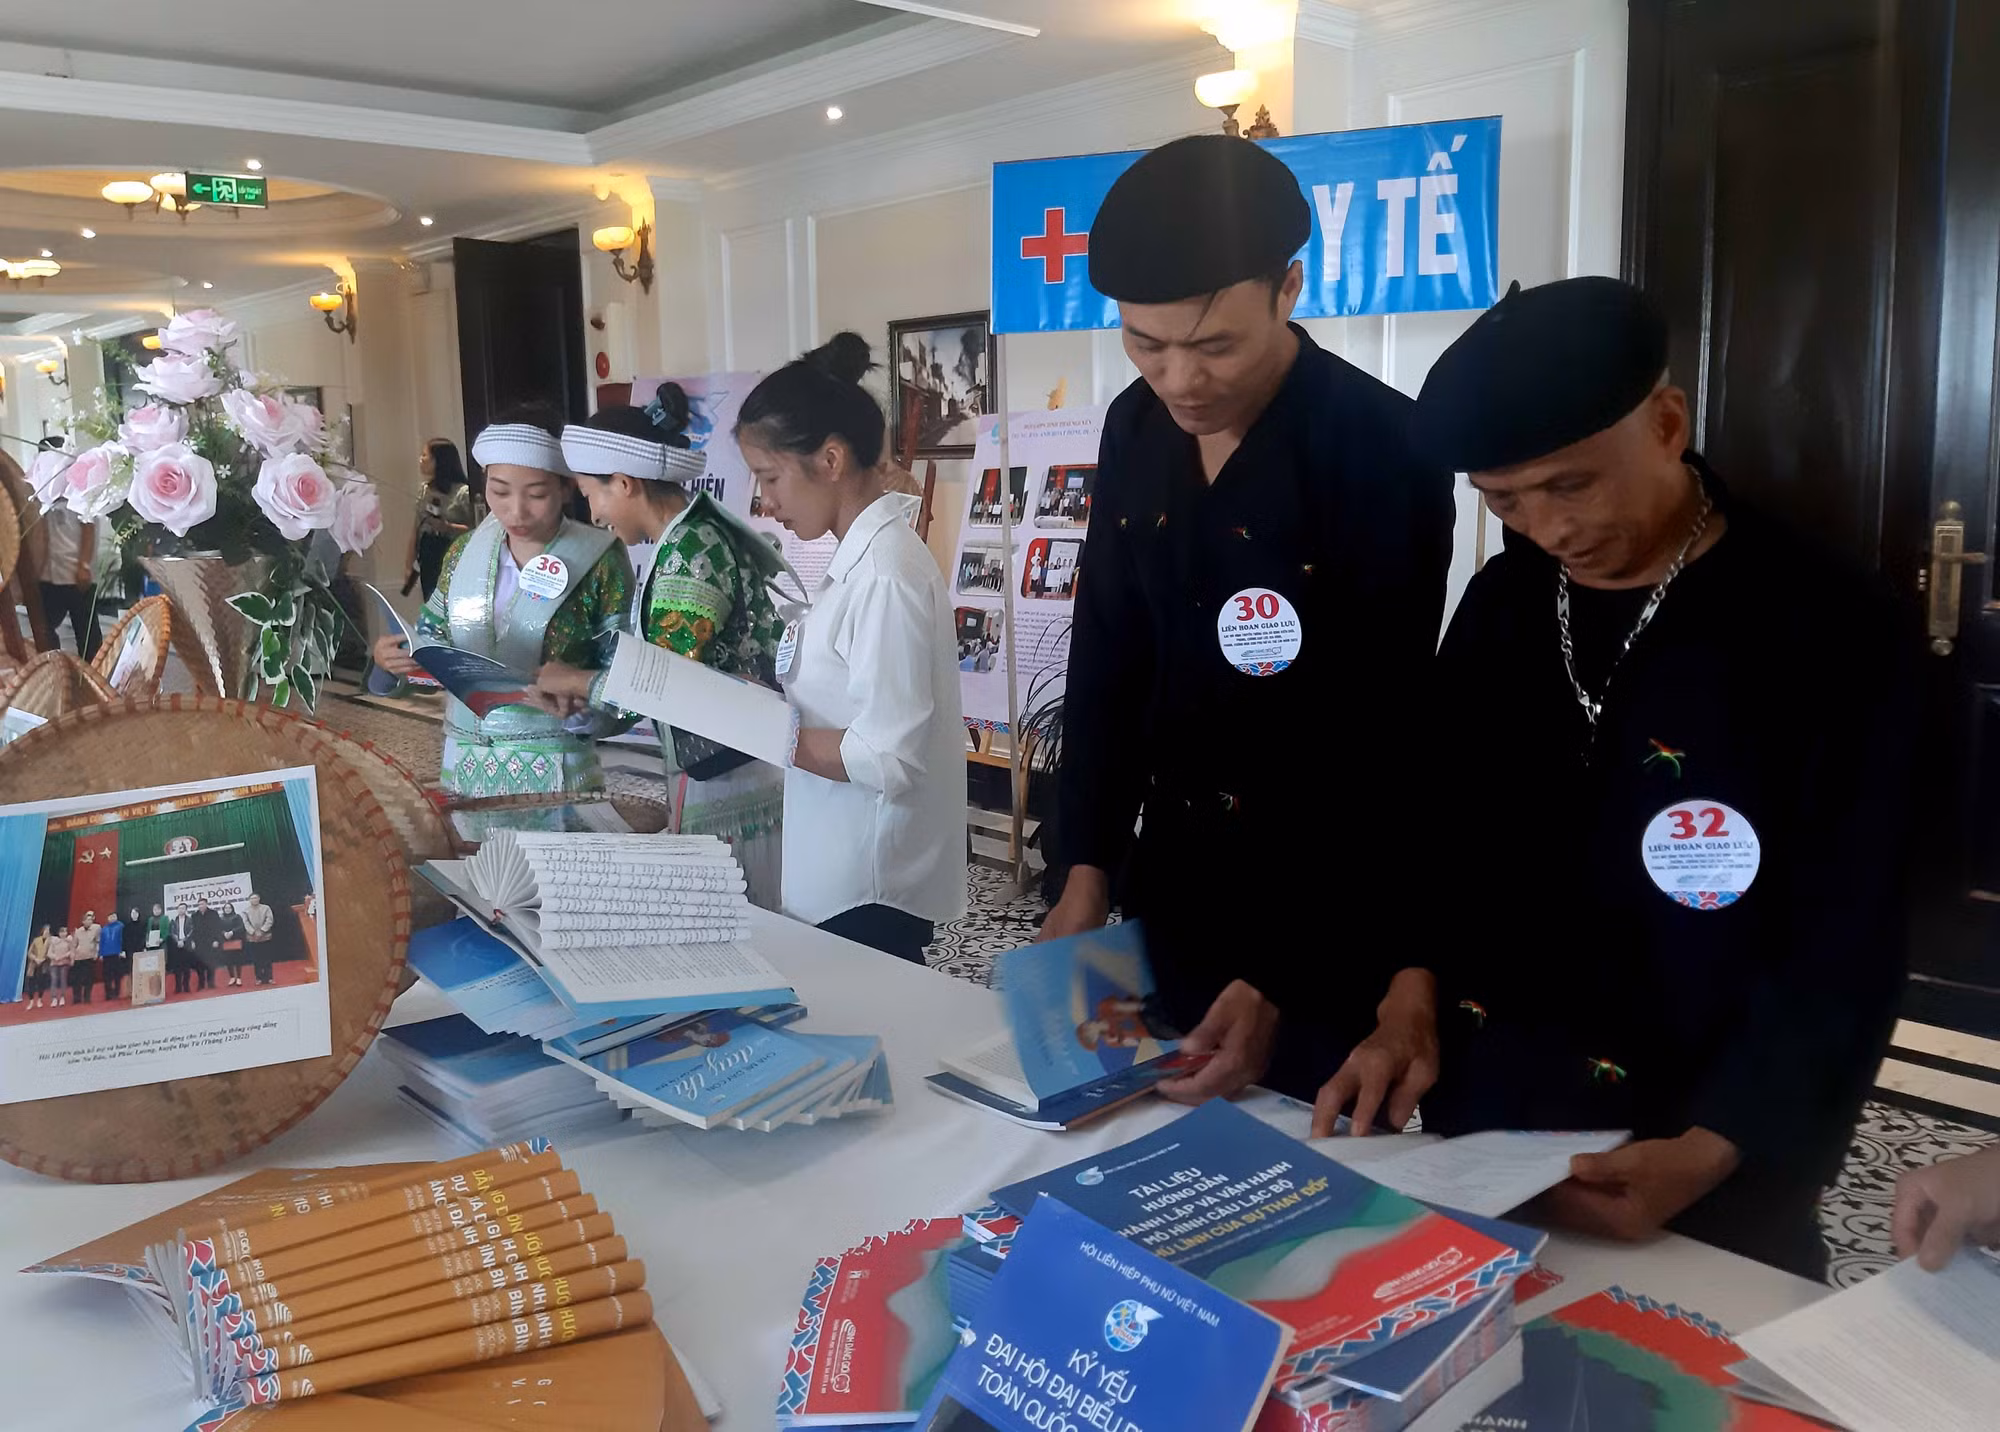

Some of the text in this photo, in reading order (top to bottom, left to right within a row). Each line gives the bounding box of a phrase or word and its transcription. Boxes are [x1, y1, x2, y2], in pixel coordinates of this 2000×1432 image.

[1312, 134, 1468, 281] Y TẾ
[536, 556, 562, 575] 36
[1221, 624, 1237, 632] LIÊN
[1239, 623, 1259, 631] HOAN
[1280, 620, 1296, 628] LƯU
[1233, 593, 1280, 622] 30
[1667, 807, 1730, 840] 32
[1648, 843, 1671, 853] LIÊN
[1673, 842, 1702, 851] HOAN
[1705, 842, 1731, 850] GIAO
[173, 886, 242, 903] PHÁT ĐỘNG
[1117, 1161, 1293, 1238] HÀNH LẬP VÀ VẬN HÀNH
[1128, 1167, 1202, 1199] TÀI LIỆU
[1141, 1173, 1230, 1213] HƯỚNG DẪN
[1142, 1178, 1294, 1246] MÔ HÌNH CÂU LẠC BỘ
[1210, 1218, 1246, 1238] CỦA
[1242, 1207, 1266, 1225] SỰ
[1261, 1192, 1302, 1215] THAY
[1079, 1241, 1098, 1258] HỘI
[1096, 1250, 1119, 1270] LIÊN
[1140, 1275, 1161, 1295] PHỤ
[1160, 1287, 1177, 1303] NỮ
[1176, 1294, 1199, 1314] VIỆT
[1197, 1307, 1220, 1328] NAM
[977, 1363, 1027, 1412] TOÀN
[984, 1333, 1124, 1432] ĐẠI HỘI ĐẠI BIỂU
[1067, 1348, 1137, 1404] KỶ YẾU
